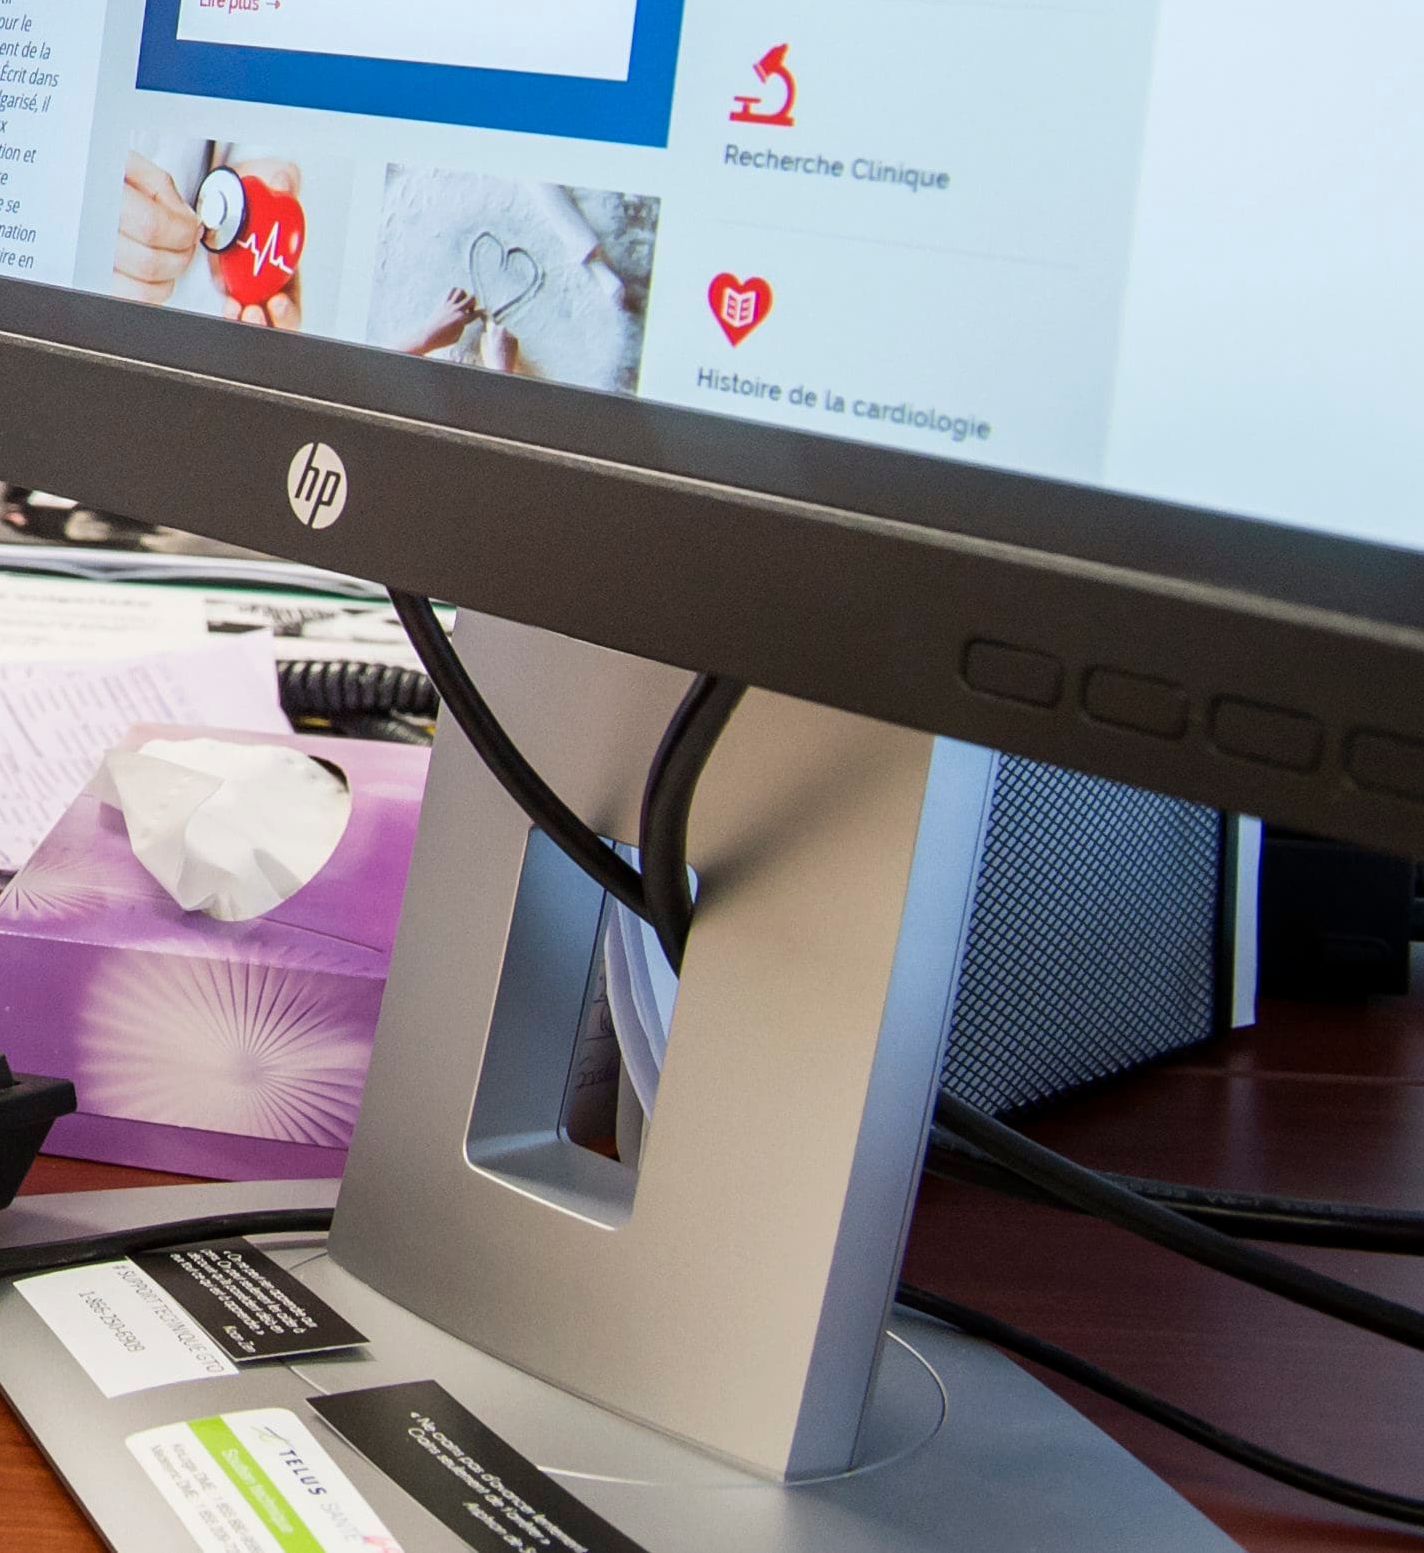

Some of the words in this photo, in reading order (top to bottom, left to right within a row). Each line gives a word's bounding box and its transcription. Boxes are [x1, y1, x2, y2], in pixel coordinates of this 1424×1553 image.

[21, 14, 32, 32] le
[21, 41, 37, 59] de
[39, 41, 51, 60] la
[0, 60, 27, 84] Écrit
[29, 67, 59, 88] dans
[41, 95, 52, 113] il
[23, 148, 37, 164] et
[724, 144, 844, 179] Recherche
[851, 157, 951, 193] Clinique
[6, 198, 20, 214] se
[18, 254, 34, 269] en
[697, 367, 782, 402] Histoire
[788, 384, 817, 408] de
[825, 389, 845, 414] la
[852, 395, 992, 443] cardiologie
[293, 441, 343, 528] hp
[279, 1449, 327, 1496] TELUS
